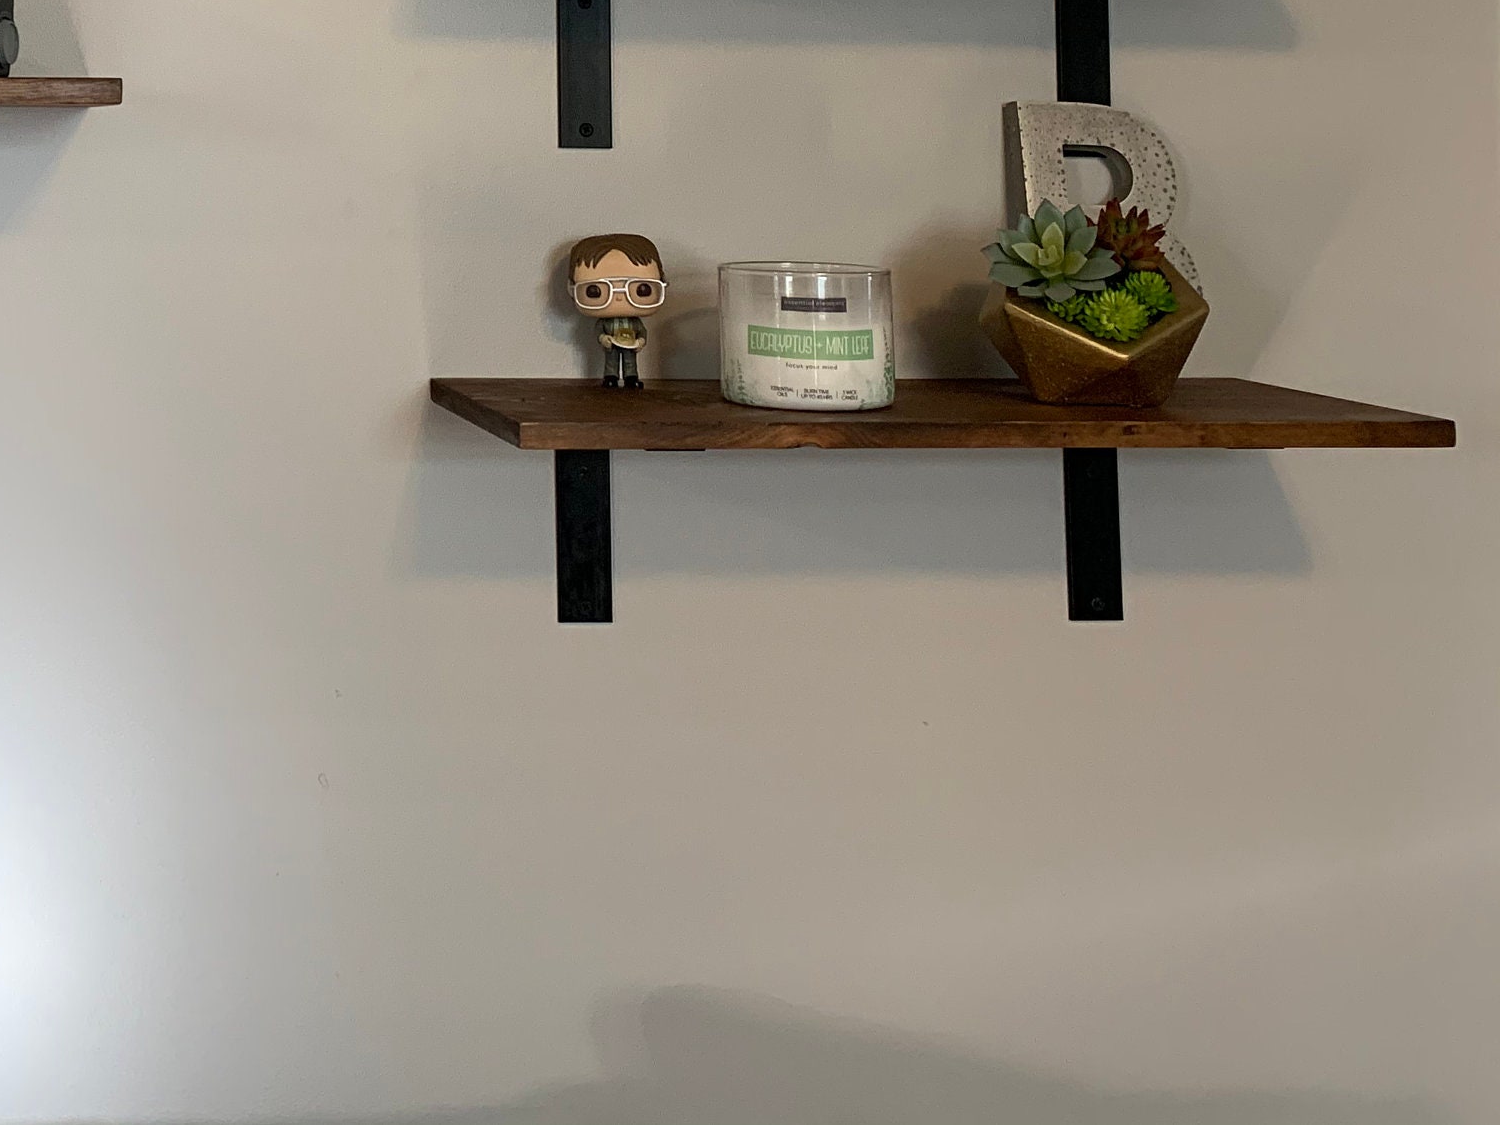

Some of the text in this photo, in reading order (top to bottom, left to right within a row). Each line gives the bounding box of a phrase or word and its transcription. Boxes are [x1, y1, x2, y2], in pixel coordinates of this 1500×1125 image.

[750, 330, 813, 355] EUCALYPTUS
[825, 336, 849, 356] MINT
[851, 335, 870, 355] LEAF
